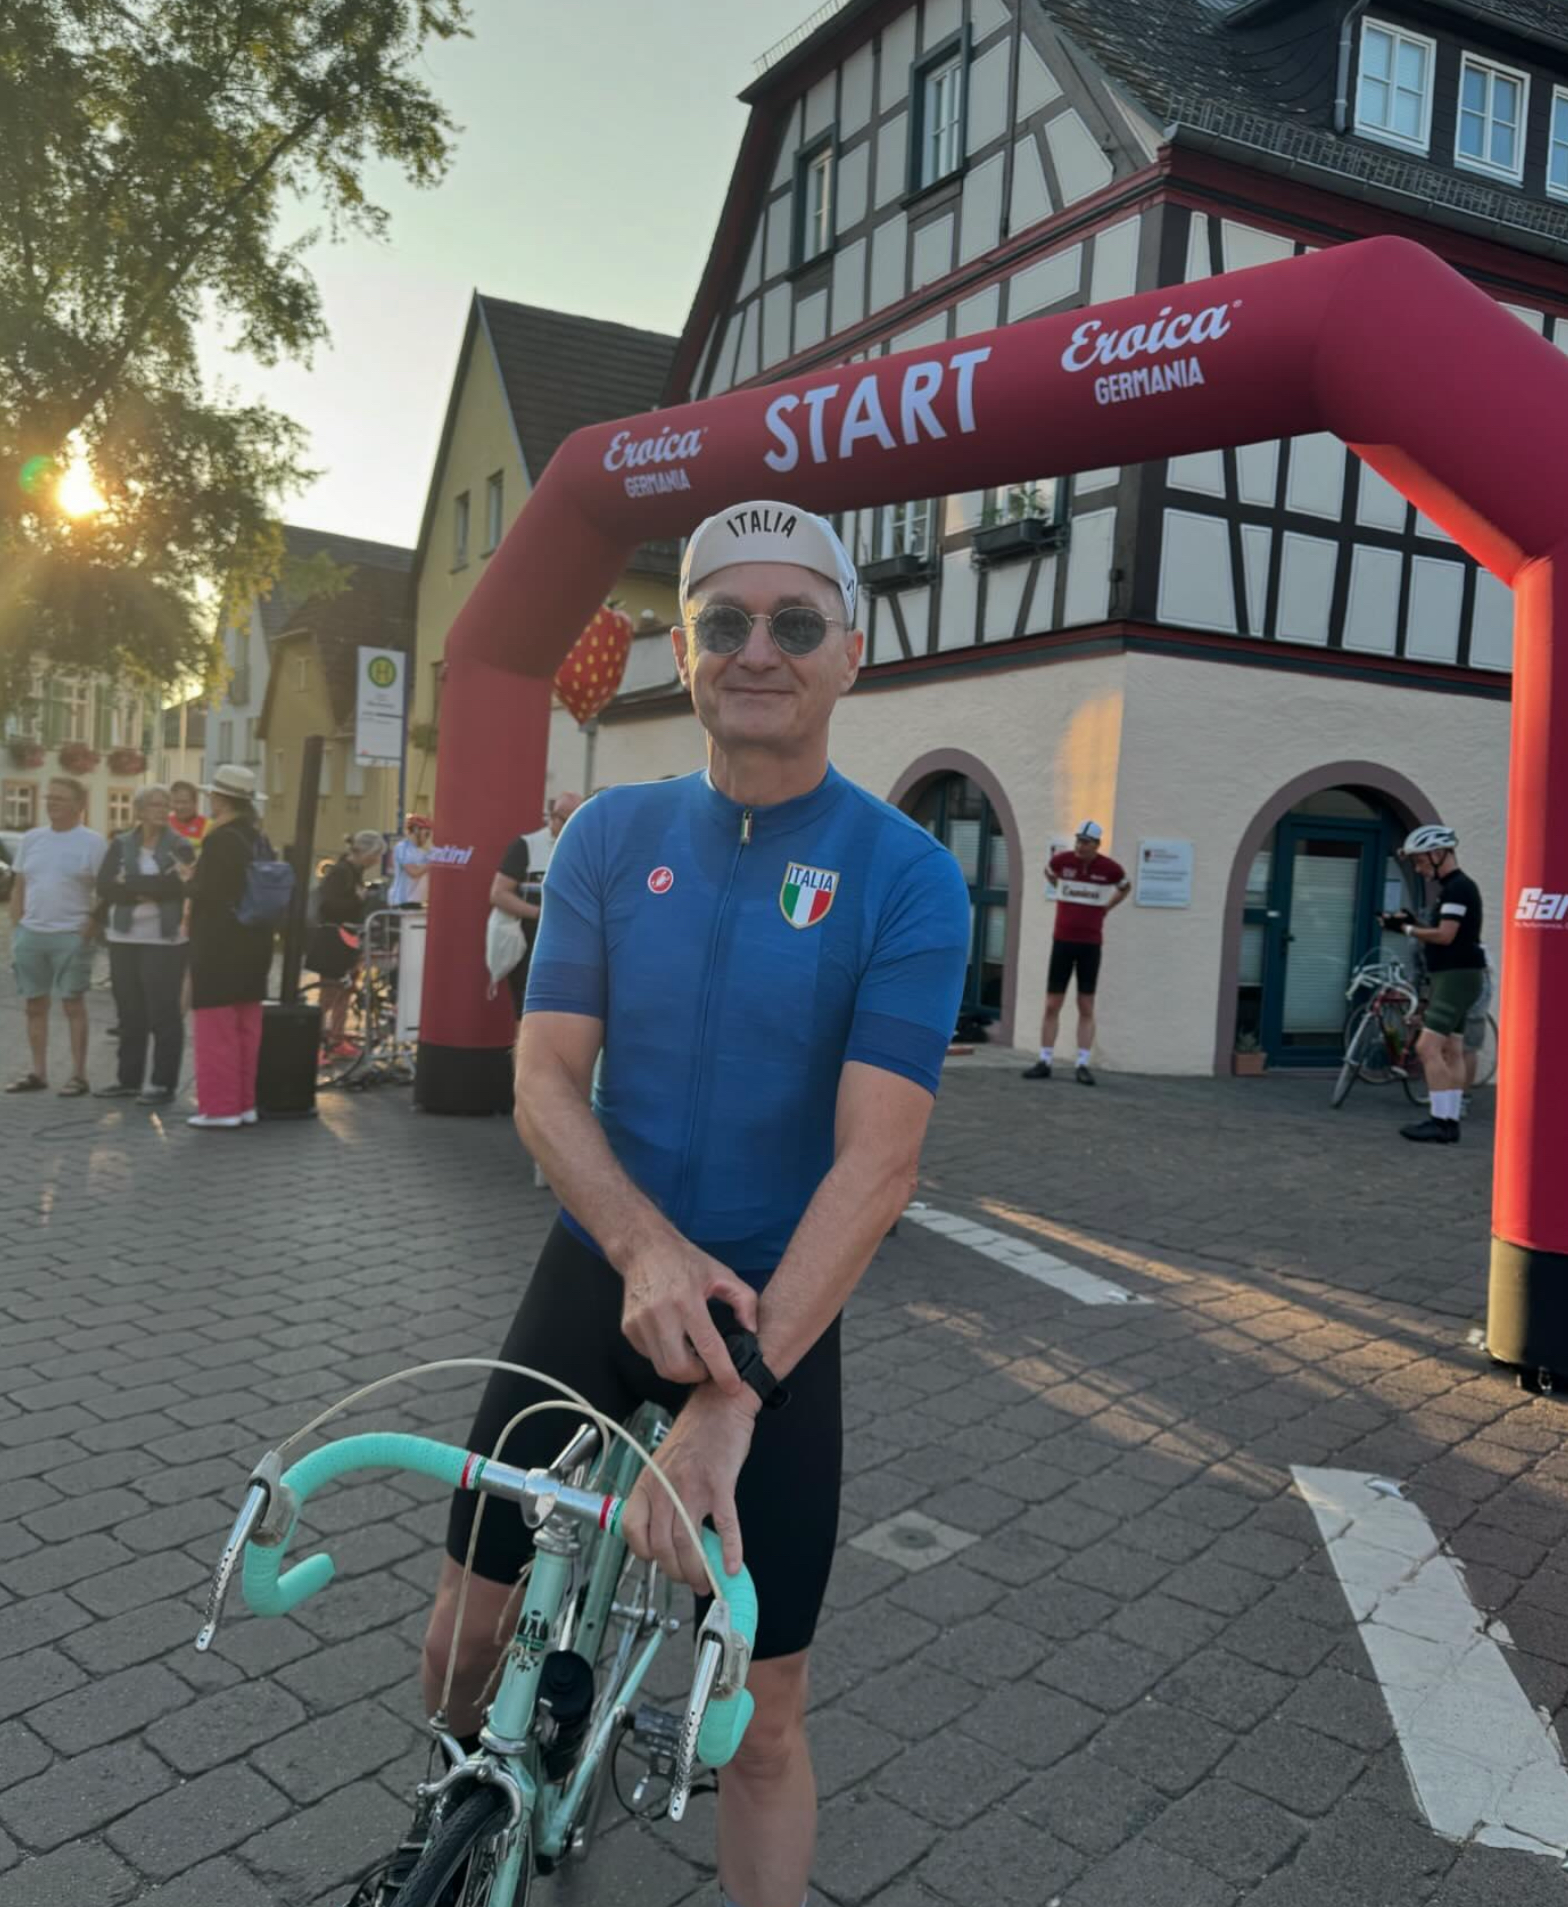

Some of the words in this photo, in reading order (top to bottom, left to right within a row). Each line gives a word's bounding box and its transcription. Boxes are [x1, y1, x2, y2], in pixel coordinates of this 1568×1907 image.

[1061, 304, 1231, 372] Eroica
[1094, 356, 1205, 405] GERMANIA
[763, 347, 992, 472] START
[603, 427, 702, 471] Eroica
[624, 468, 691, 498] GERMANIA
[726, 509, 797, 538] ITALIA
[787, 865, 834, 892] ITALIA
